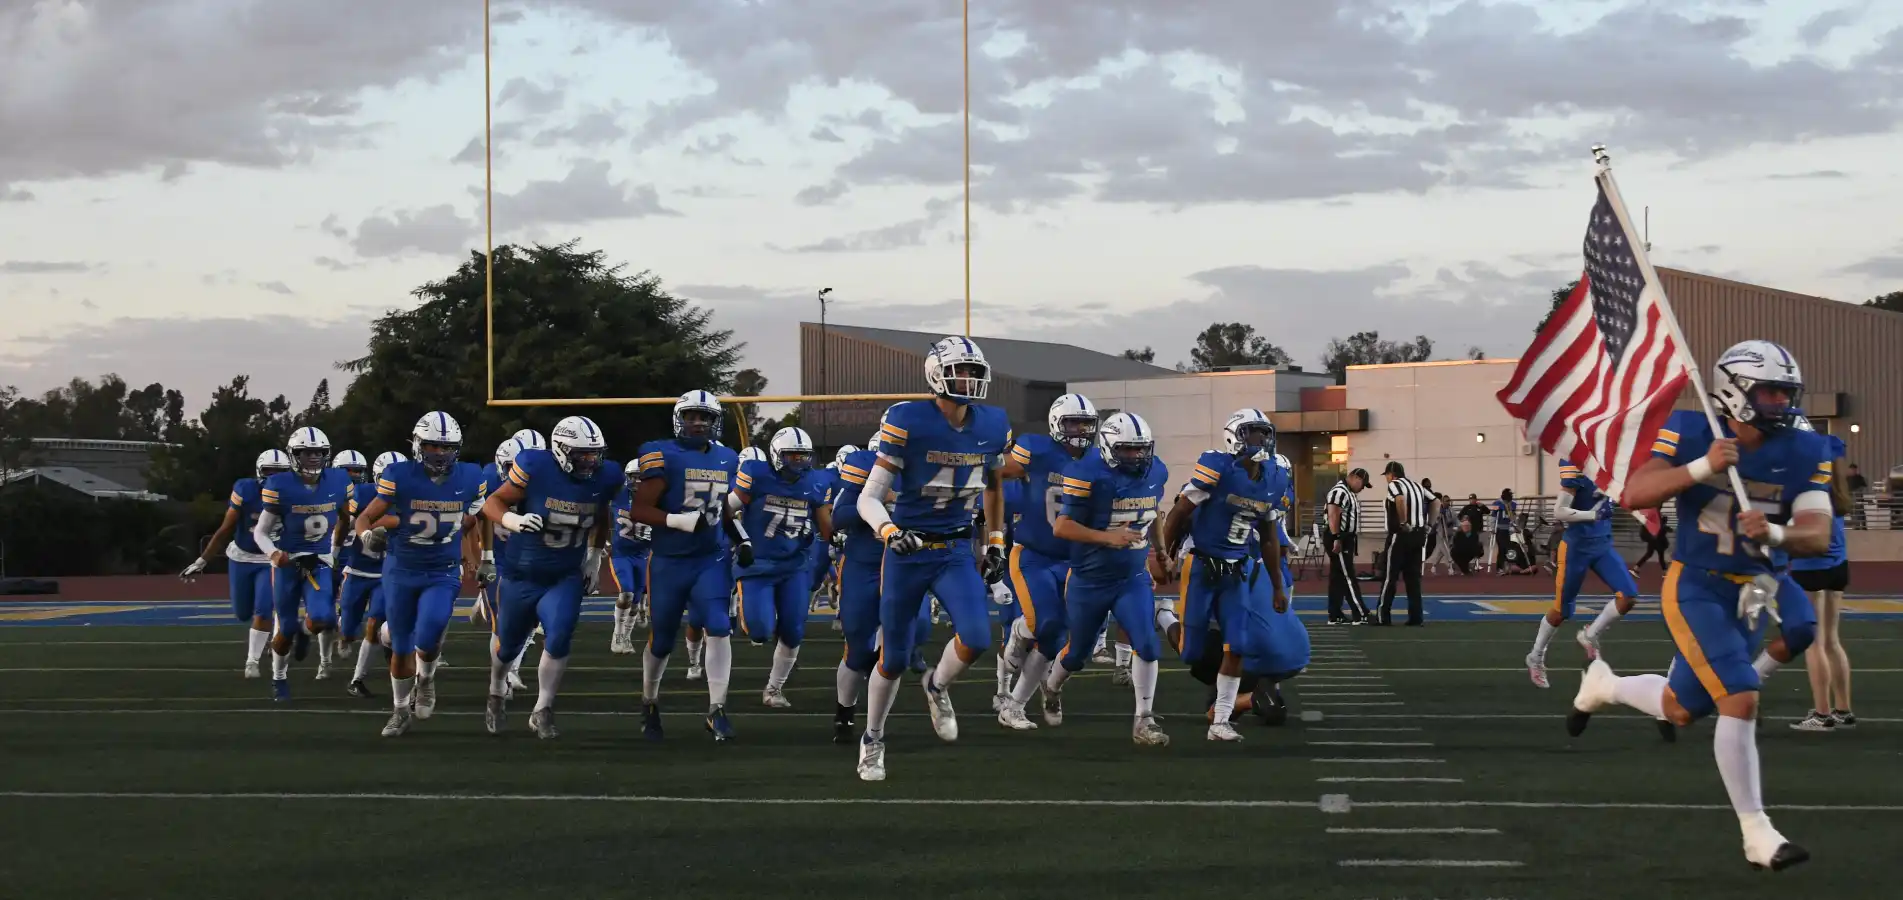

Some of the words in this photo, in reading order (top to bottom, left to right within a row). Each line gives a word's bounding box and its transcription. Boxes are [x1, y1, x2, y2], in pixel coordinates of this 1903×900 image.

[683, 481, 729, 526] 55
[921, 466, 987, 510] 44
[409, 511, 463, 544] 27
[763, 504, 808, 539] 75
